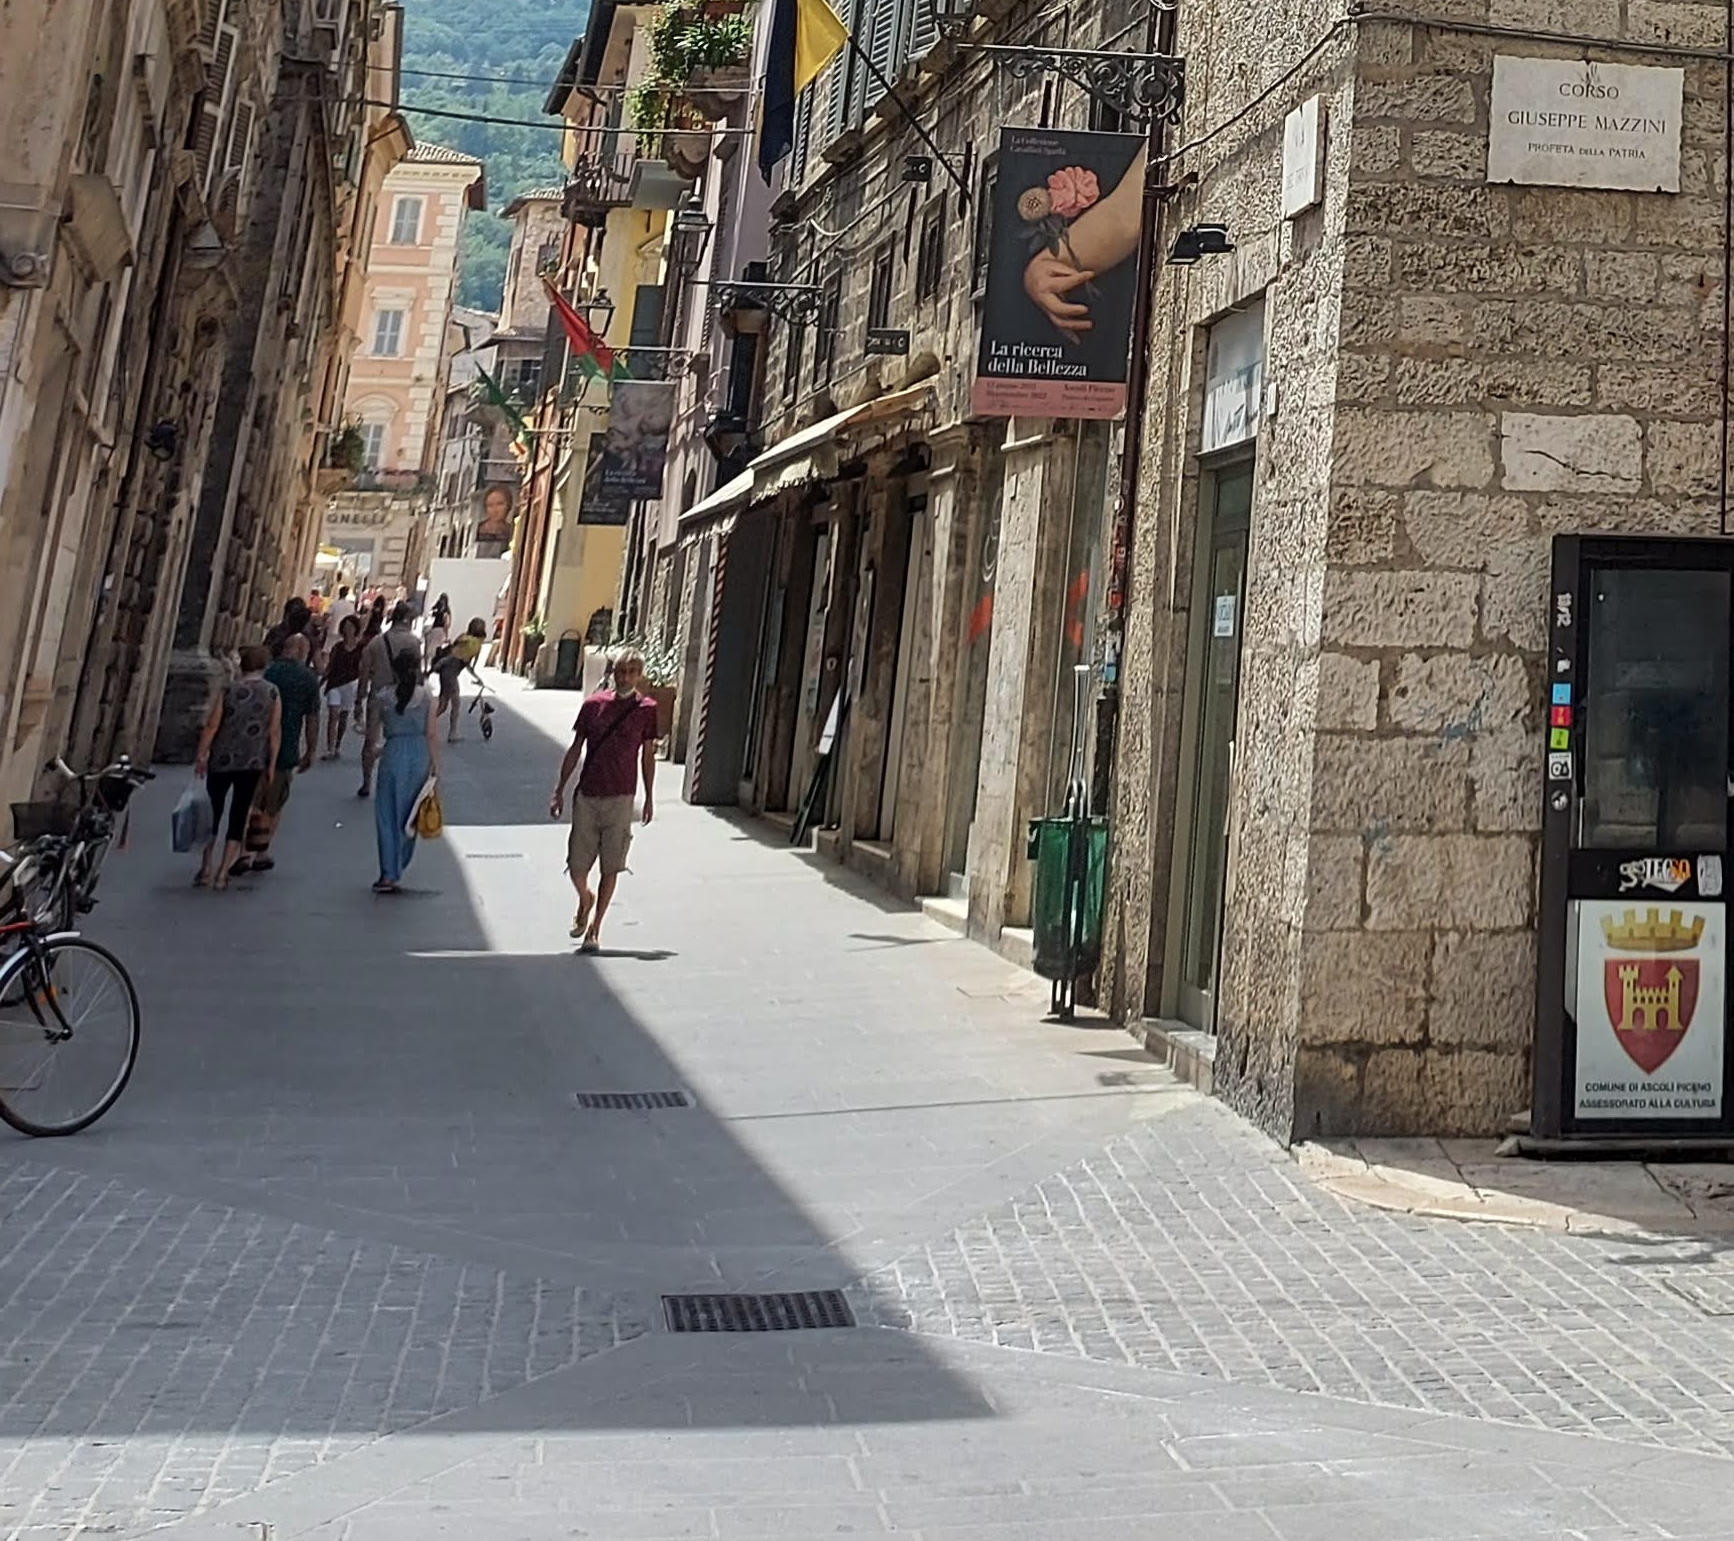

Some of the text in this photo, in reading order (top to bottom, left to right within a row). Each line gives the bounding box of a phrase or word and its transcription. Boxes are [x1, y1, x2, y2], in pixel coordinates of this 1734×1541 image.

[1559, 82, 1620, 100] CORSO
[1508, 110, 1667, 135] GIUSEPPE MAZZINI
[1528, 142, 1575, 155] PROFETA
[1609, 148, 1646, 160] PATRIA
[991, 340, 1063, 358] La ricerca
[988, 357, 1087, 377] della Bellezza
[1585, 1082, 1626, 1093] COMUNE
[1628, 1083, 1639, 1092] DI
[1640, 1082, 1675, 1093] ASCOLI
[1579, 1098, 1647, 1109] ASSESSORATO
[1649, 1098, 1673, 1109] ALLA
